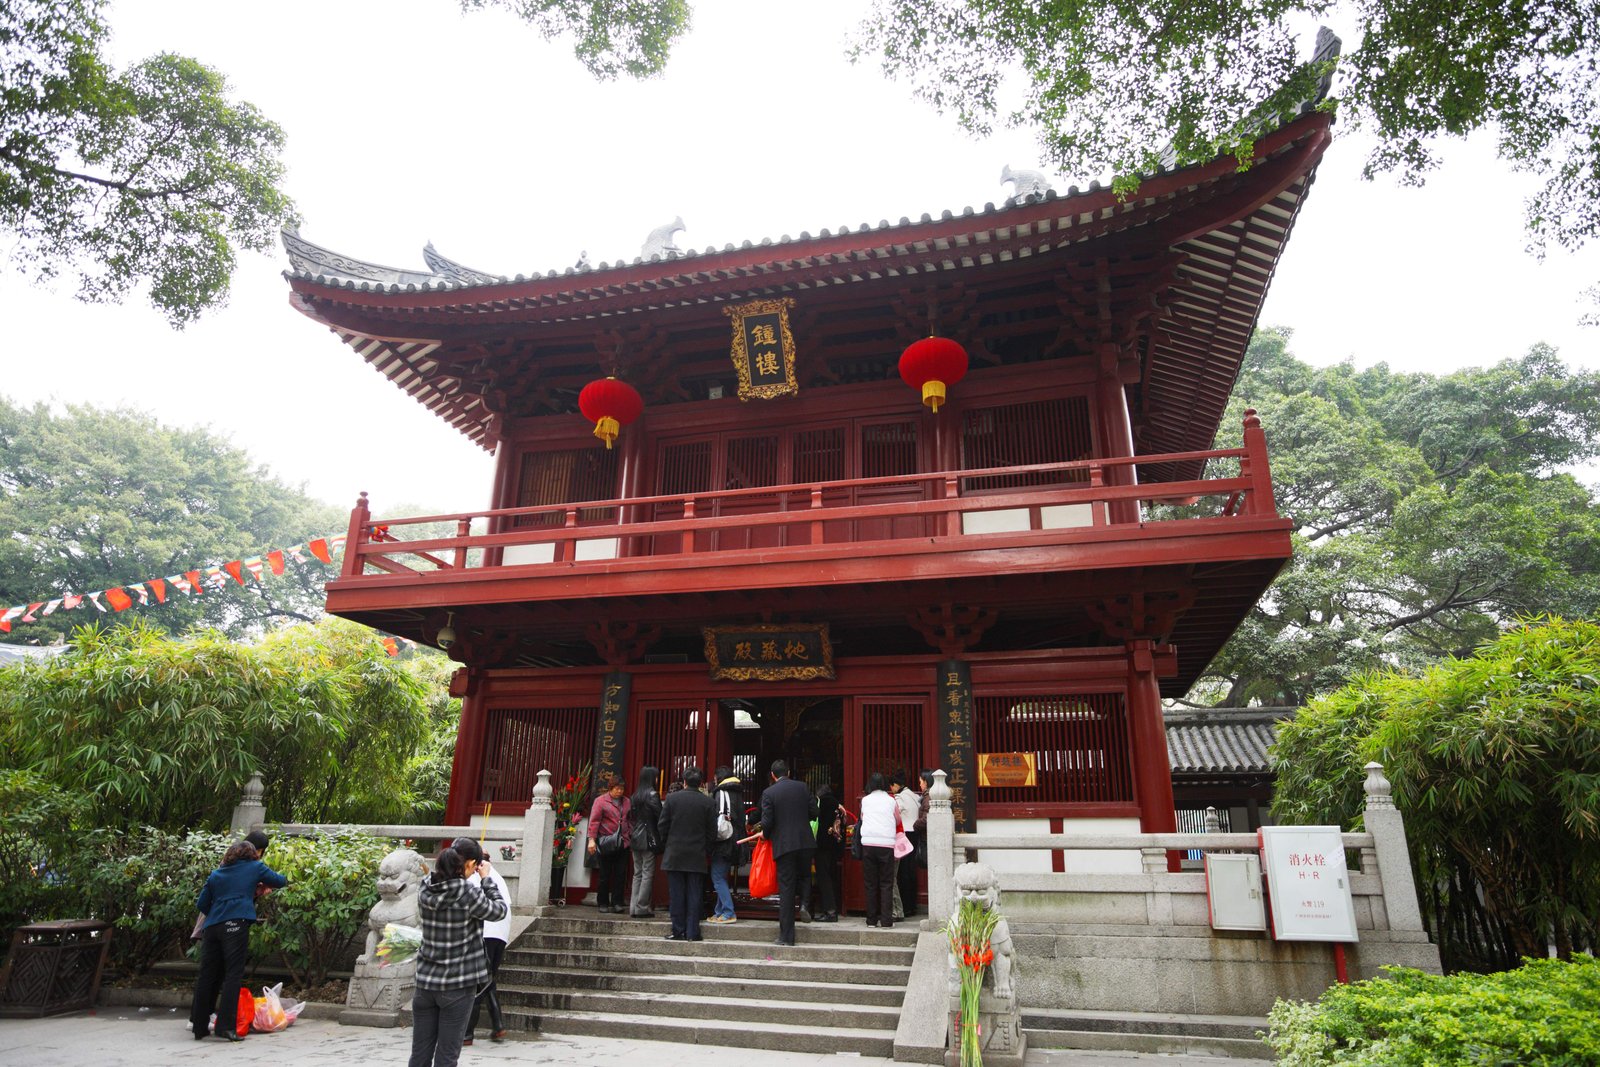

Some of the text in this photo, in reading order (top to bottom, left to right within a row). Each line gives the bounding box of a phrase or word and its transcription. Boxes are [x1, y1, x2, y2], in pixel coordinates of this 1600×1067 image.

[751, 324, 780, 376] 鐘樓
[1289, 853, 1326, 866] 消火栓
